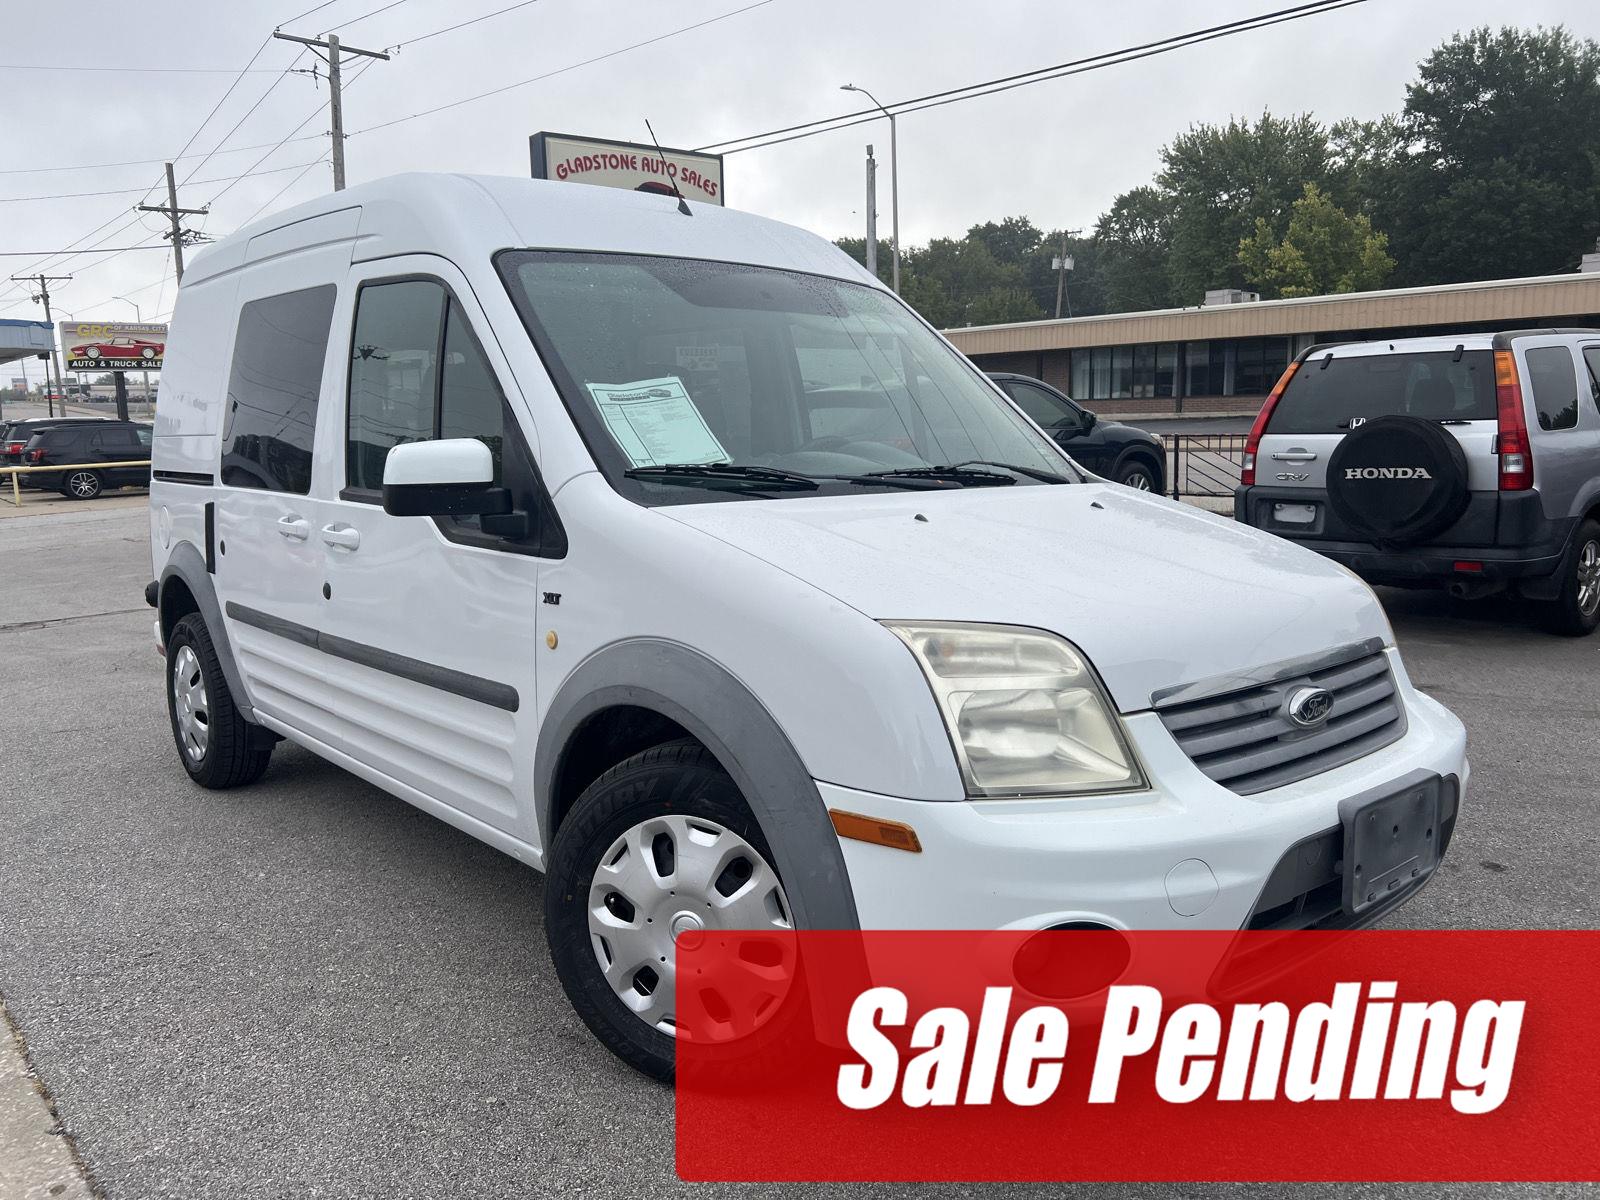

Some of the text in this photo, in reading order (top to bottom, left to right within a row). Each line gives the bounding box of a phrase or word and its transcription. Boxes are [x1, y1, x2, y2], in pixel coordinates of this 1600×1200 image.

[556, 154, 718, 197] GLADSTONE AUTO SALES
[76, 325, 113, 338] GRC
[1276, 472, 1311, 482] CR-V
[1344, 467, 1433, 480] HONDA
[1307, 695, 1328, 719] Ford
